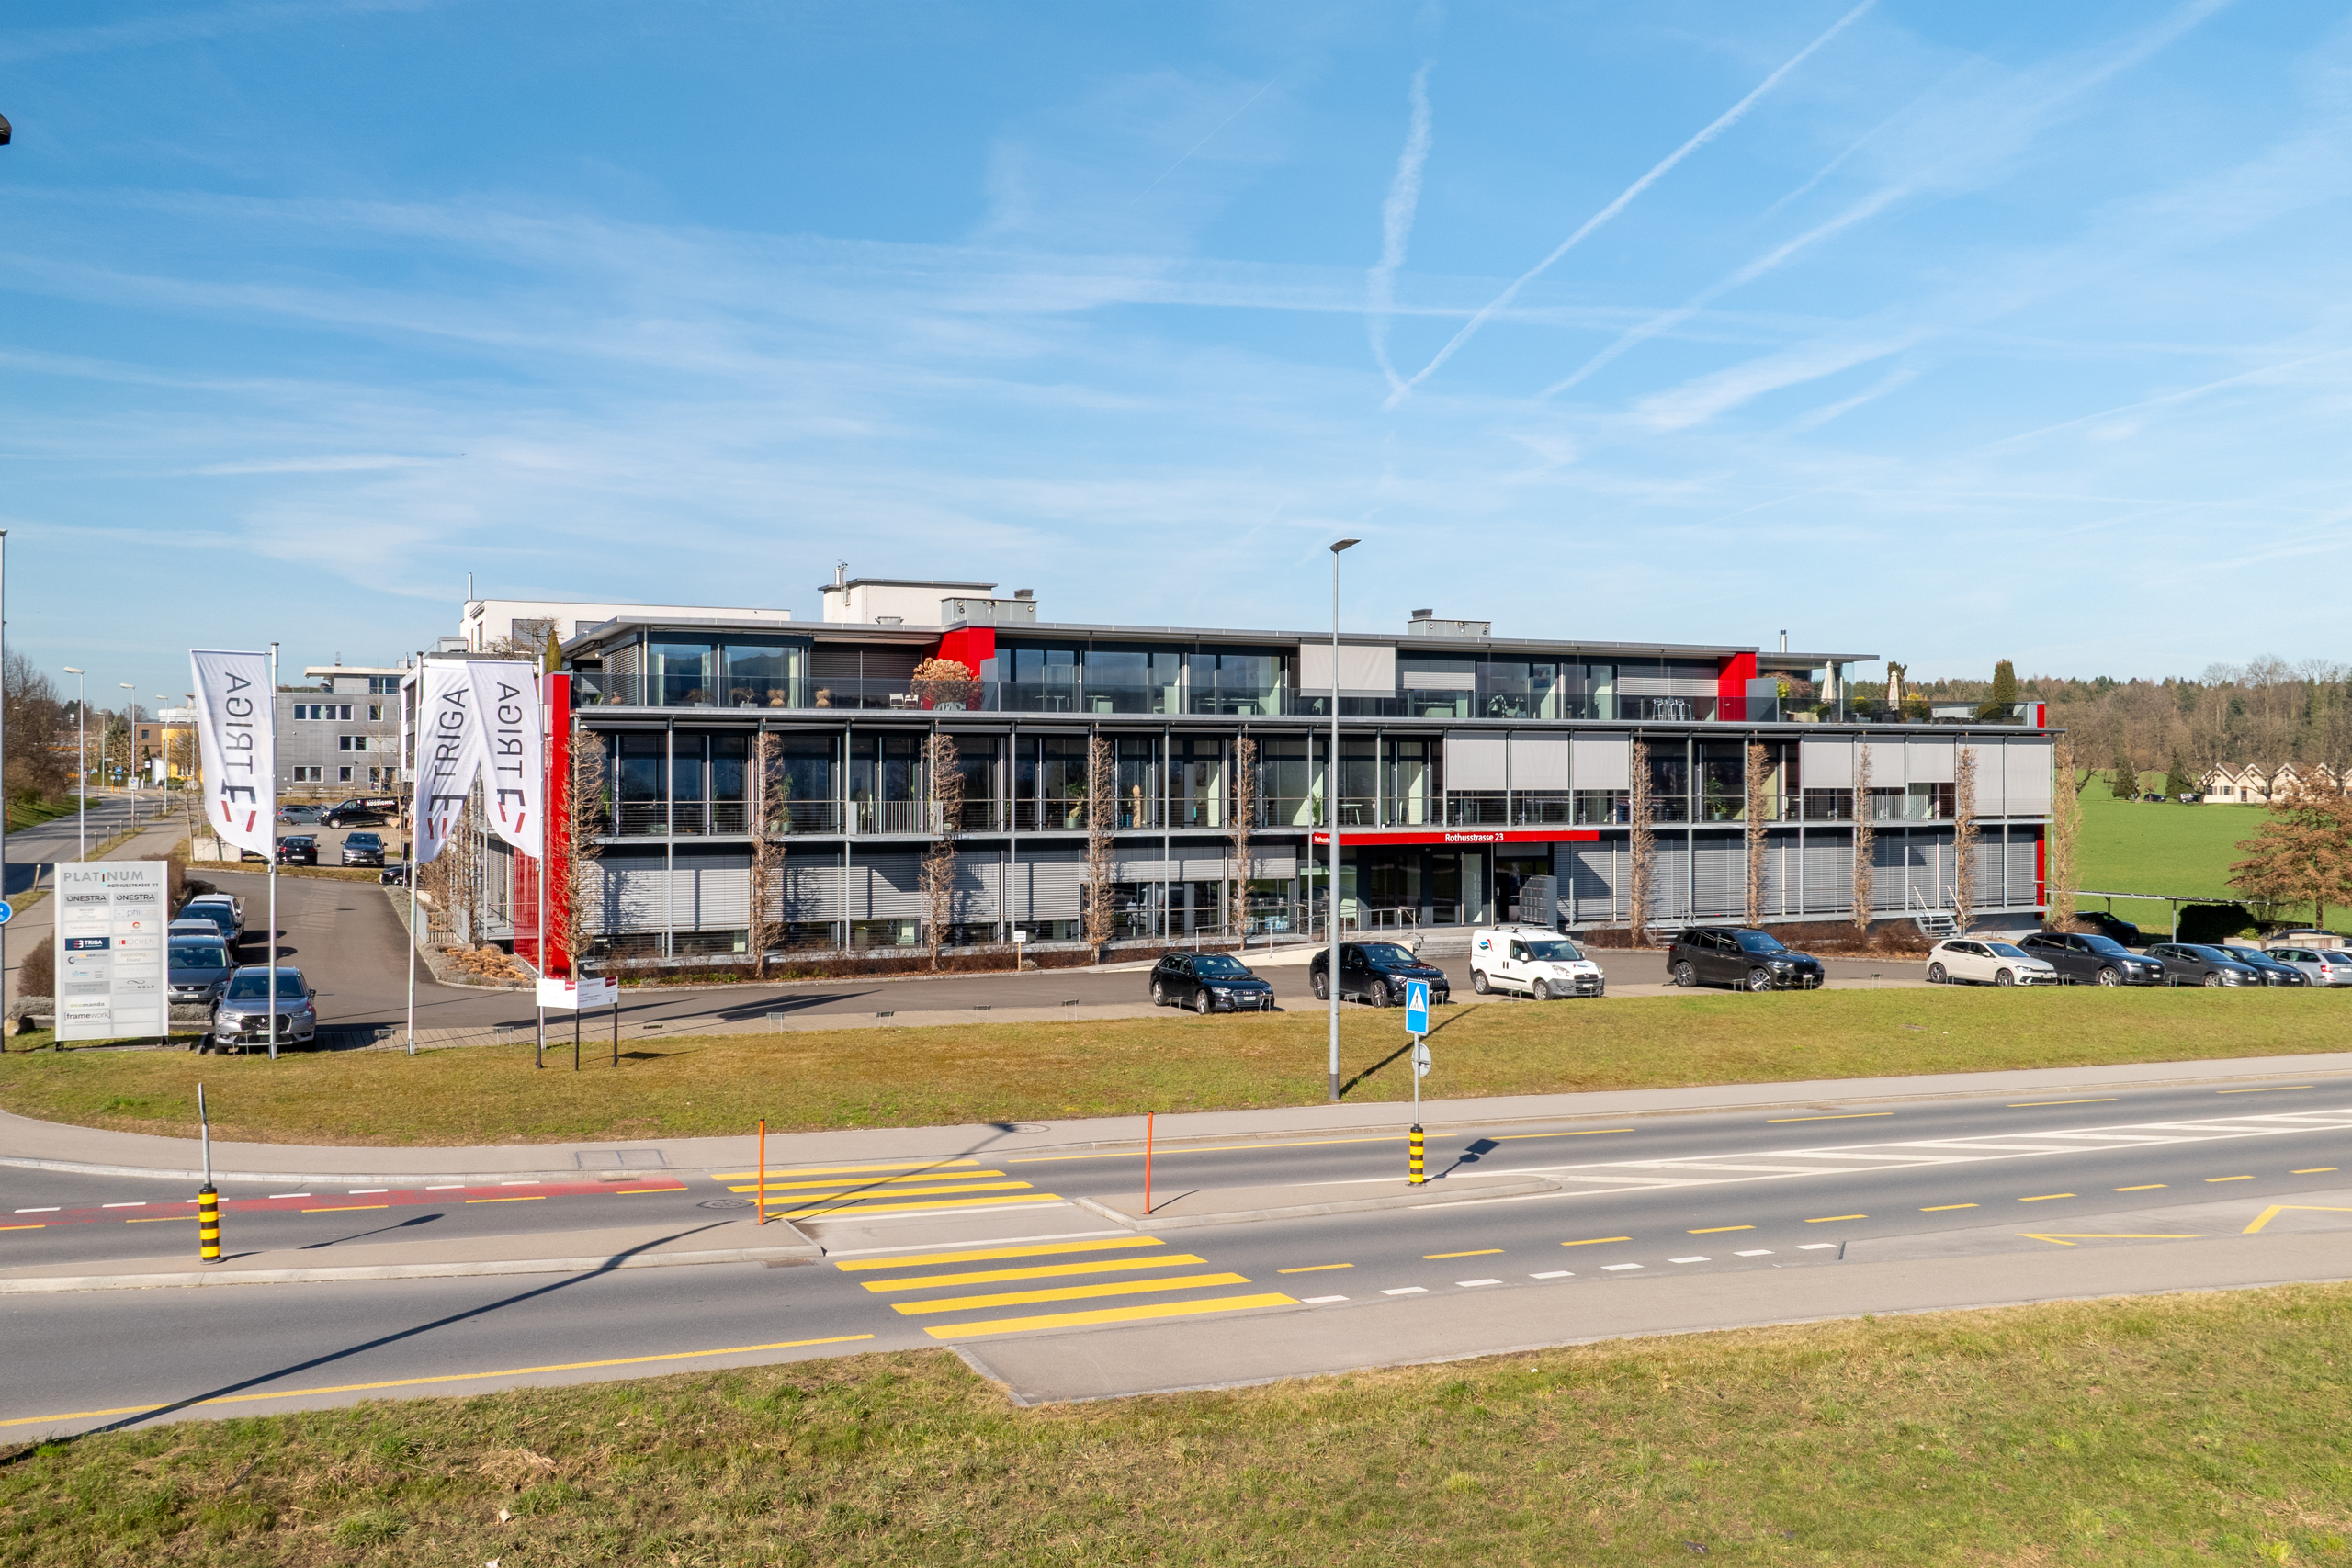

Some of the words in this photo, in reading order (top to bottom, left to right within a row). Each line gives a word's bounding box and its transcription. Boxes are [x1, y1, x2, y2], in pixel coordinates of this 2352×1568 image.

[434, 688, 469, 784] TRIGA
[1445, 833, 1494, 842] Rothusstrasse
[1494, 832, 1504, 841] 23
